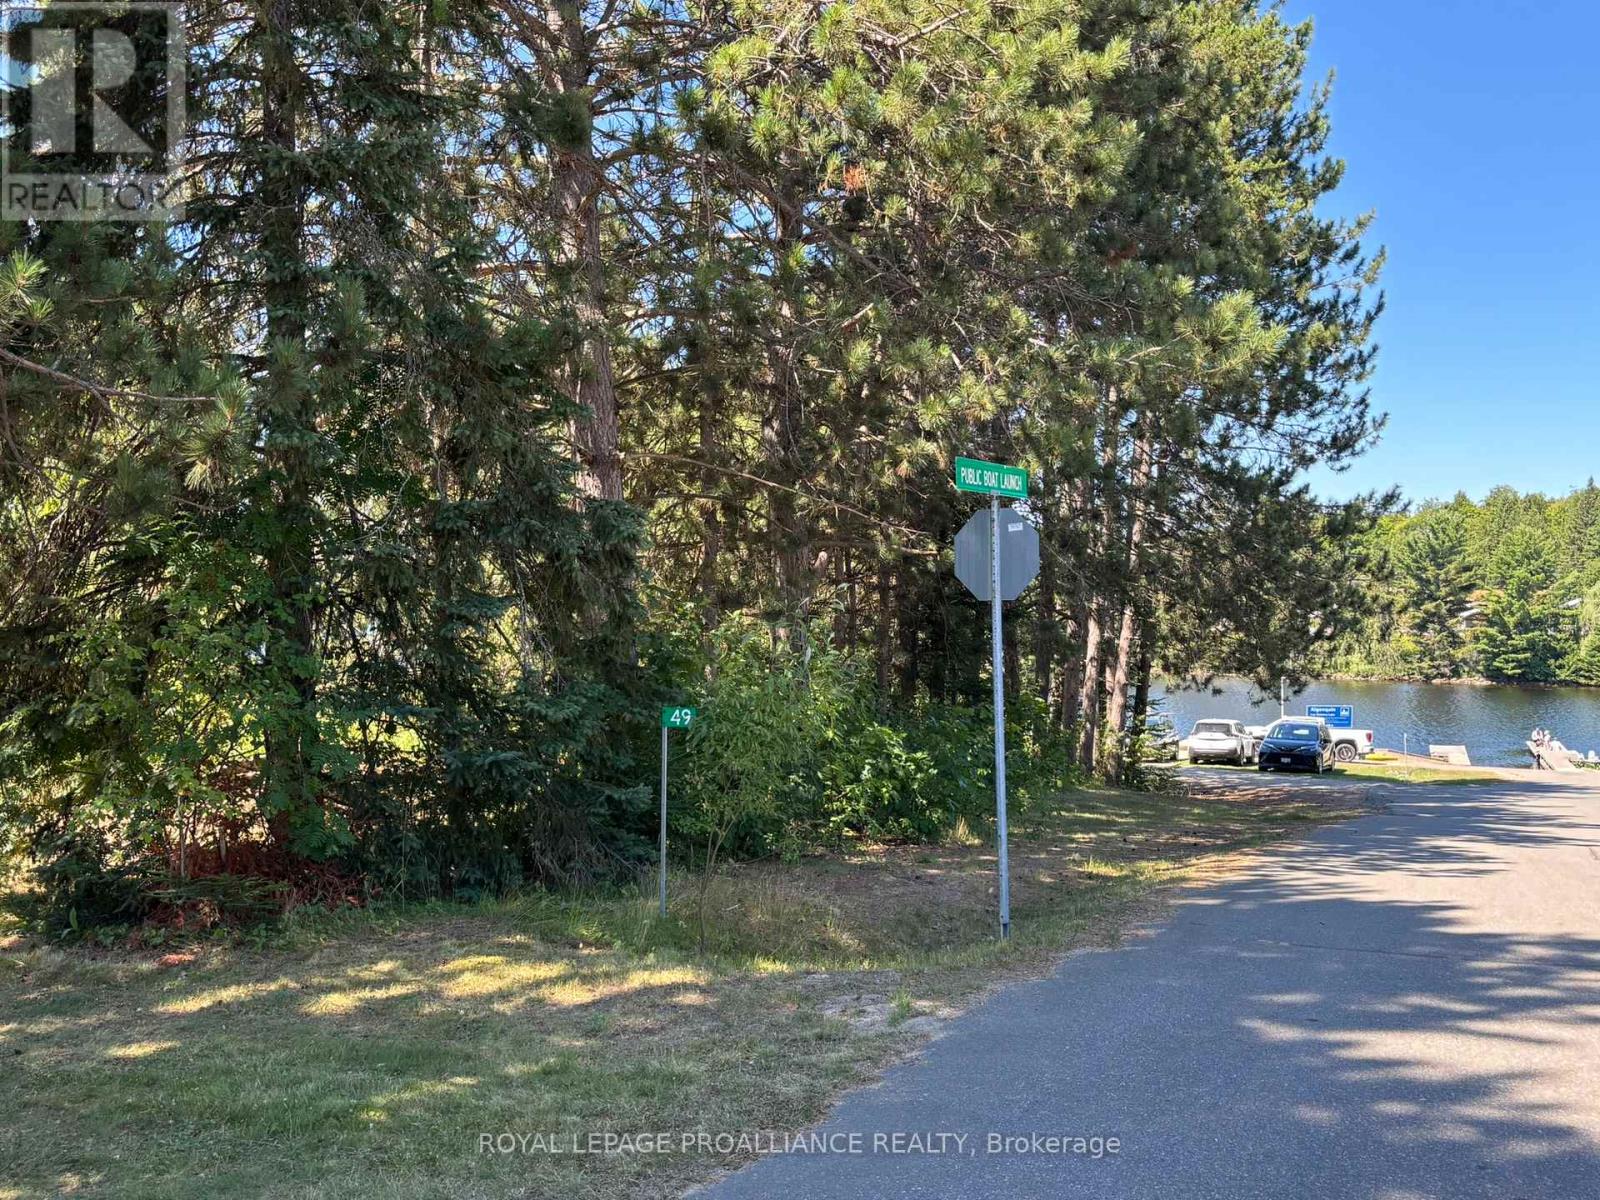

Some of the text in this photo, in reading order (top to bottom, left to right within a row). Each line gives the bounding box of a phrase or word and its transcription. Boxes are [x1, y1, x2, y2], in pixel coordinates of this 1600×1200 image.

[961, 467, 1022, 490] PUBLIC BOAT LAUNCH
[670, 709, 691, 725] 49
